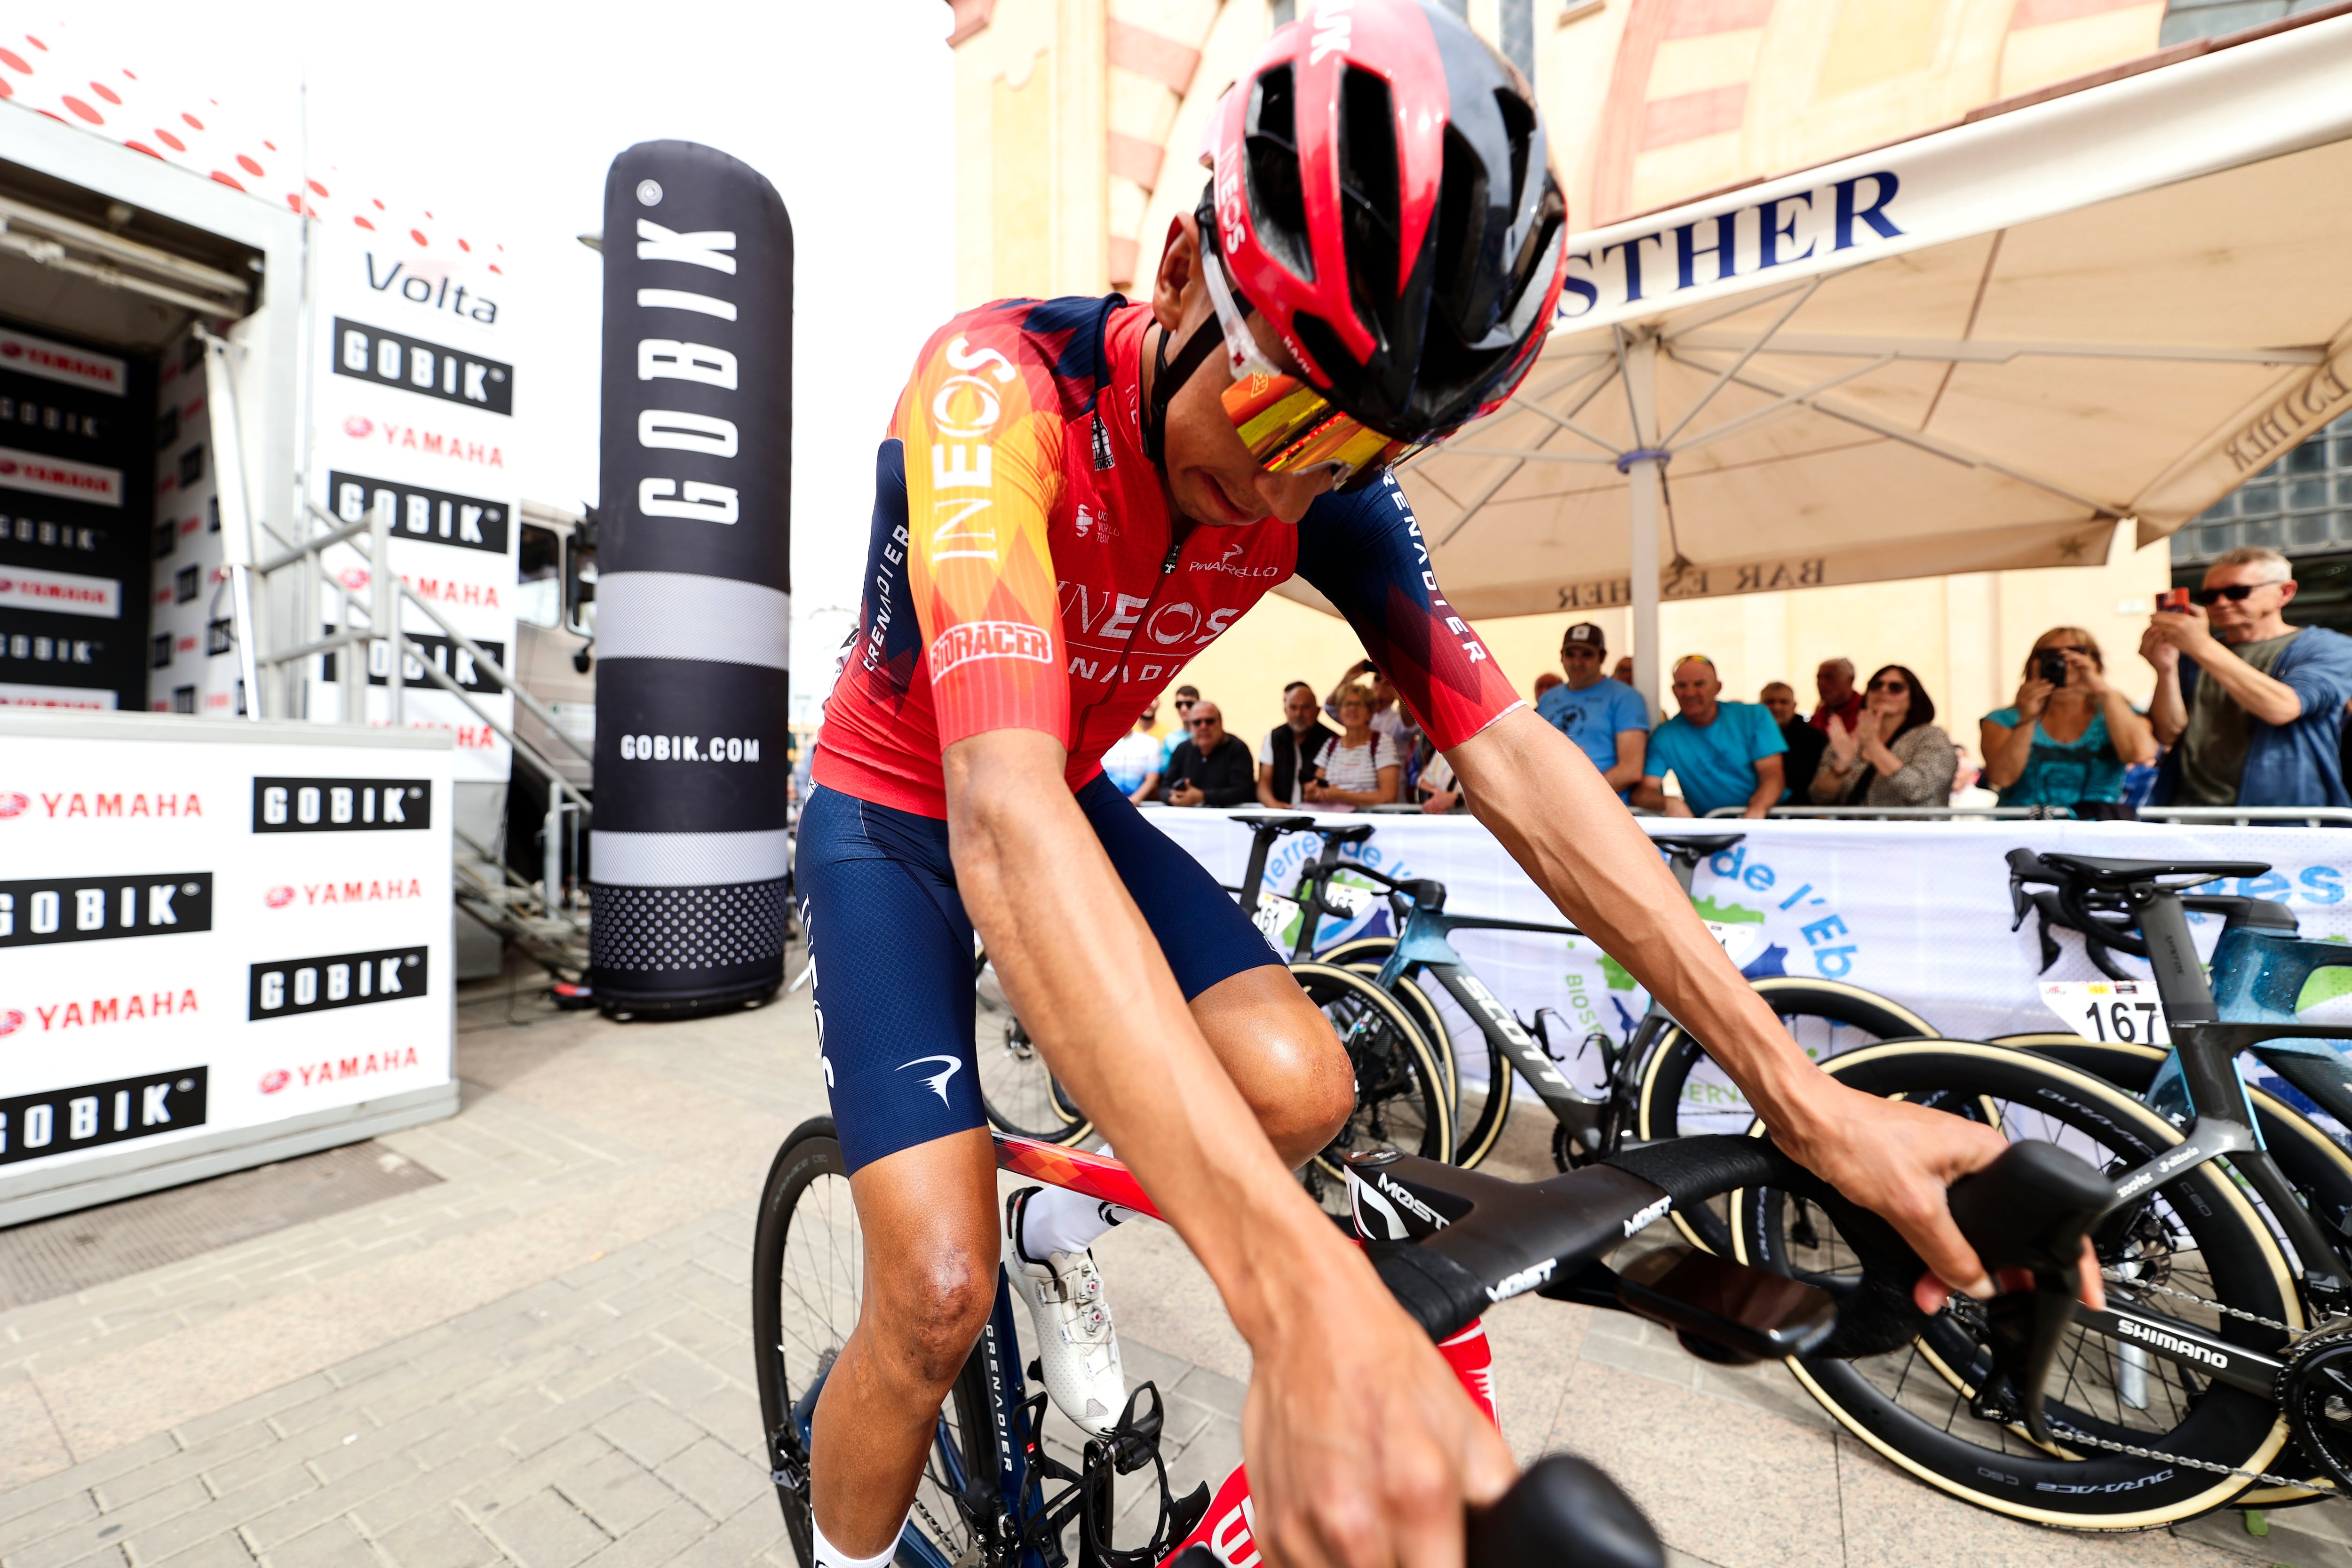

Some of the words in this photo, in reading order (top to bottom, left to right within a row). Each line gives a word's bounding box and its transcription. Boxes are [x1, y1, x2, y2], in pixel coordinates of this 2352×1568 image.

[1220, 141, 1246, 255] INEOS
[1556, 170, 1909, 320] STHER
[366, 251, 498, 324] Volta
[343, 329, 488, 403] GOBIK
[636, 218, 739, 525] GOBIK
[383, 423, 504, 468] YAMAHA
[932, 337, 1017, 566] INEOS
[339, 482, 484, 543] GOBIK
[1097, 532, 1109, 544] TEAM
[1098, 510, 1108, 521] UCI
[1098, 521, 1119, 536] WORLD
[398, 575, 499, 608] MAHA
[1189, 561, 1278, 578] PINARELLO
[1383, 473, 1486, 663] RENADIER
[1057, 580, 1240, 645] INEOS
[368, 638, 478, 685] OBIK
[932, 623, 1052, 681] BIORACER
[620, 734, 760, 763] GOBIK.COM
[40, 792, 203, 818] YAMAHA
[263, 787, 406, 825] GOBIK
[1263, 835, 1318, 888] Terre
[304, 878, 421, 906] YAMAHA
[1709, 845, 1776, 891] de
[1779, 883, 1859, 978] l'Eb
[36, 989, 199, 1031] YAMAHA
[260, 957, 404, 1011] GOBIK
[1565, 974, 1605, 1034] BIOSF
[1455, 974, 1573, 1090] SCOTT
[2086, 1002, 2156, 1043] 167
[298, 1046, 419, 1088] YAMAHA
[0, 1082, 172, 1154] OBIK
[1378, 1172, 1451, 1231] MOST
[2117, 1319, 2228, 1369] SHIMANO
[985, 1324, 1013, 1472] GRENADIER
[2034, 1468, 2174, 1494] DURA-ACE
